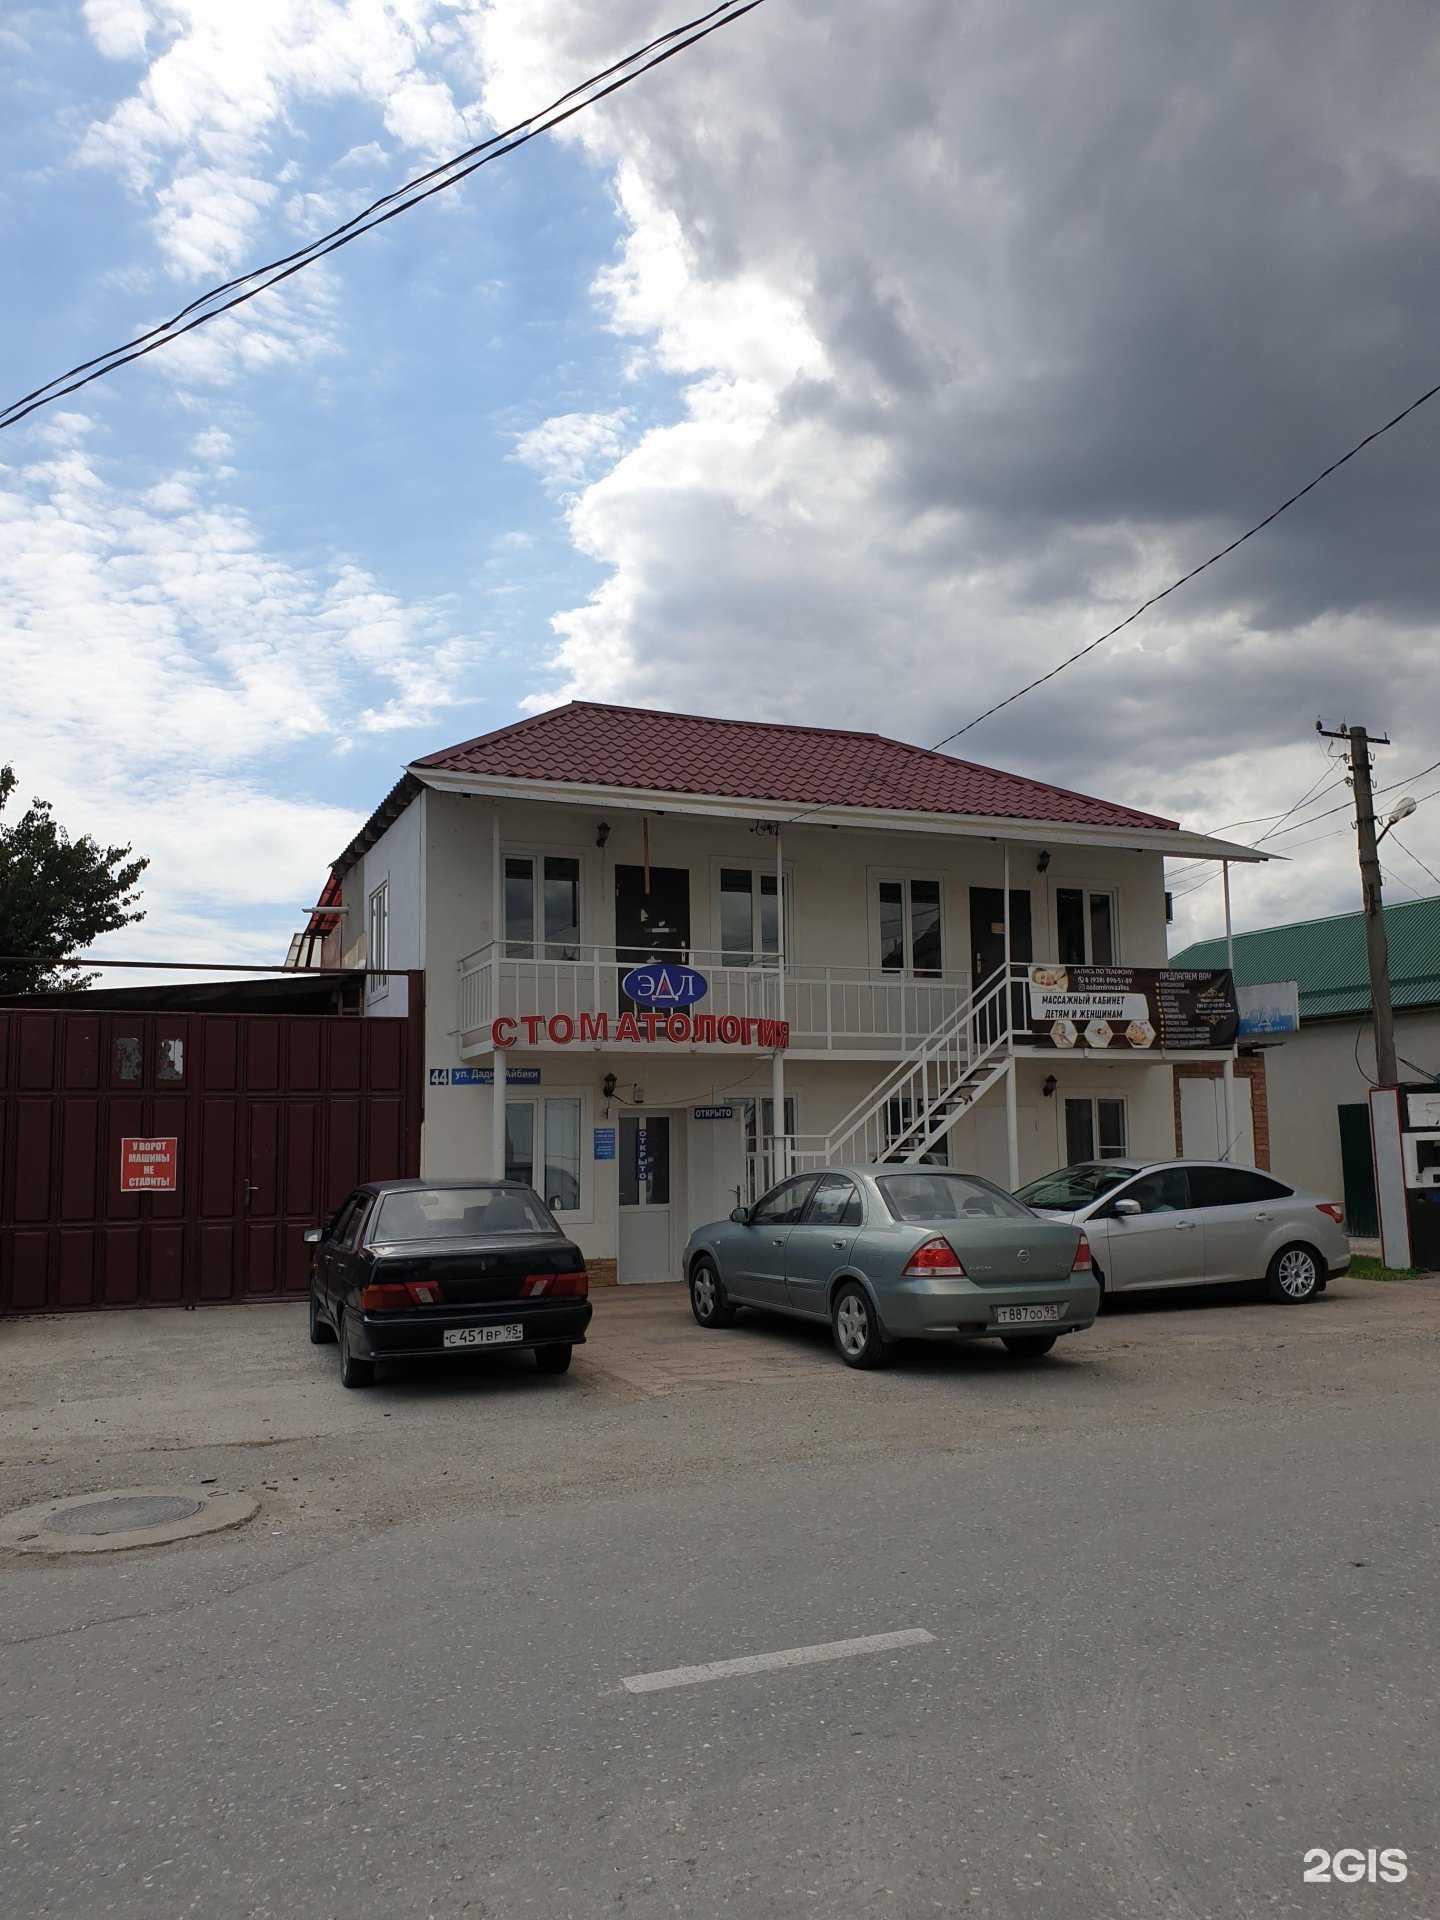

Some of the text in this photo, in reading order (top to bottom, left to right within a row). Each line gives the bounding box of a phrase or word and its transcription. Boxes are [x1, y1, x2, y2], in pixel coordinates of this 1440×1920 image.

[637, 968, 696, 1001] ЭДЛ
[1042, 994, 1125, 1005] МАССАЖНЫЙ КАБИНЕТ
[1045, 1009, 1123, 1019] ДЕТЯМ И ЖЕНЩИНАМ
[491, 1012, 790, 1049] СТОМАТОЛОГИЯ
[431, 1070, 448, 1083] 44
[455, 1072, 470, 1080] ул.
[695, 1109, 732, 1118] ОТКРЫТО
[132, 1142, 166, 1150] У ВОРОТ
[128, 1154, 170, 1162] МАШИНЫ
[638, 1130, 648, 1180] ОТКРЫТО
[144, 1166, 155, 1174] НЕ
